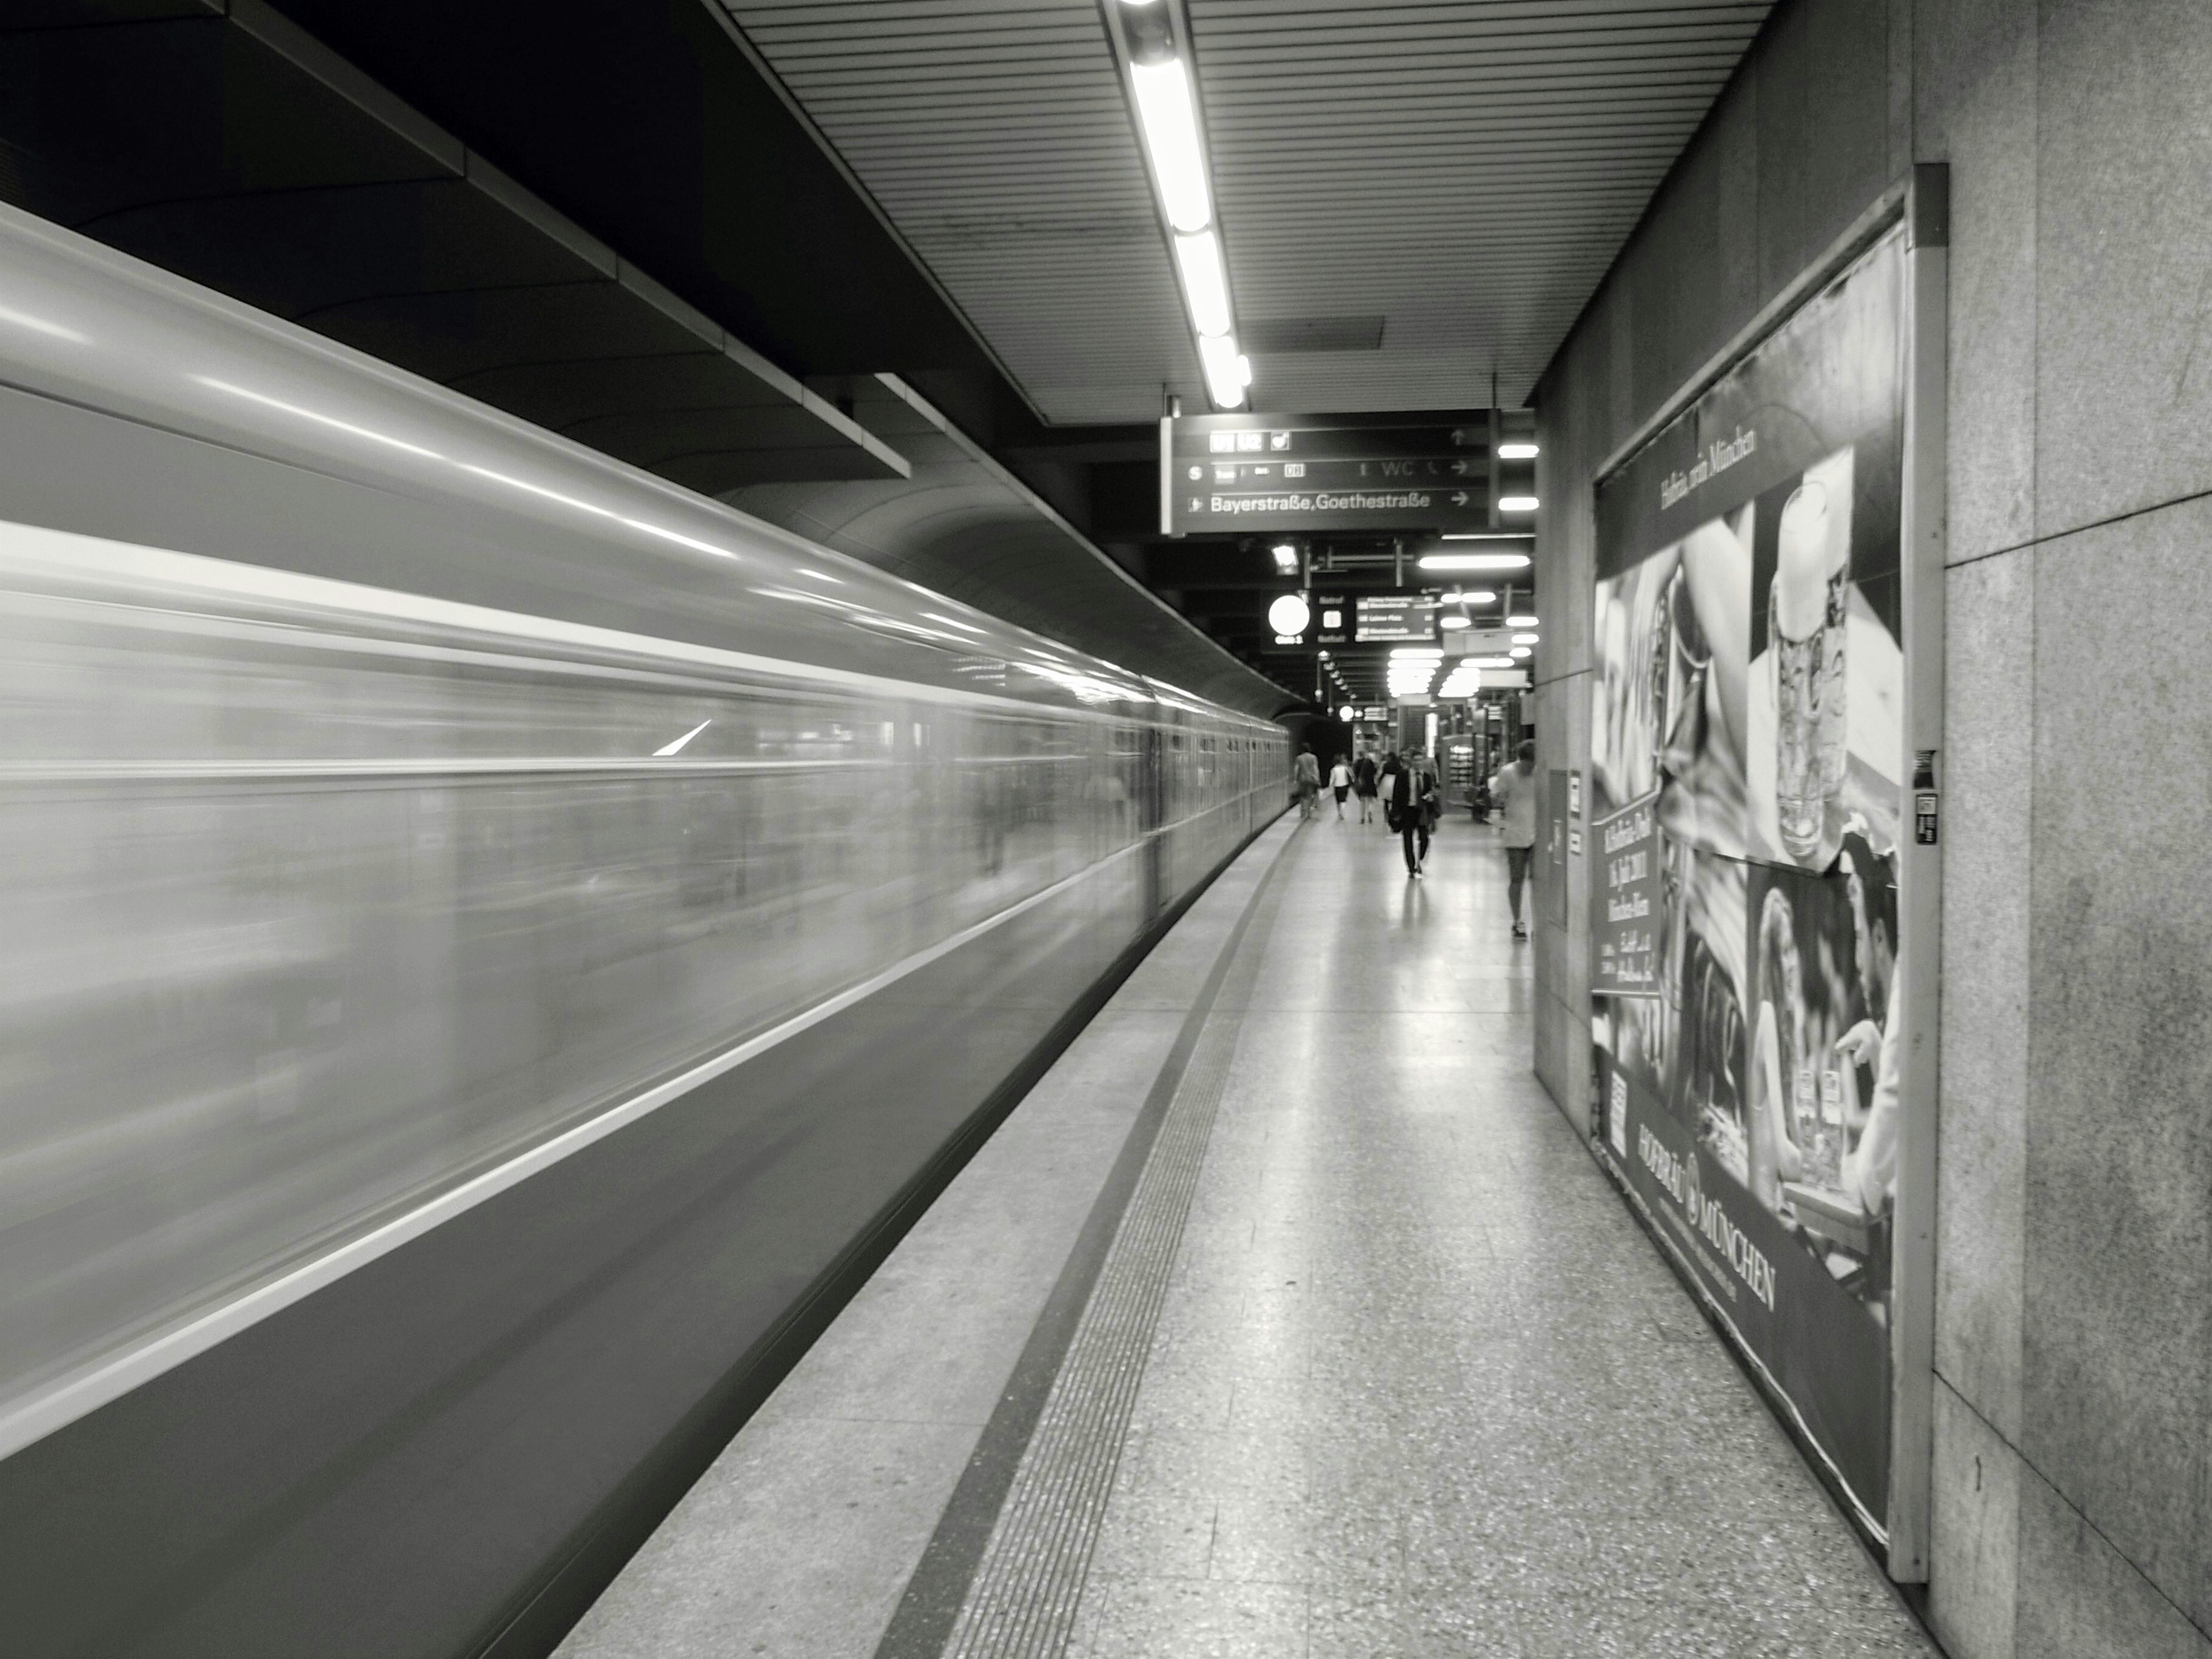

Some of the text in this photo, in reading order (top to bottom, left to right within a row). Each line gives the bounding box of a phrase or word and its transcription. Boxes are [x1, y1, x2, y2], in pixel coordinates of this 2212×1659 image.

[1238, 434, 1261, 451] U2
[1709, 424, 1756, 477] München
[1381, 461, 1413, 476] WC
[1698, 1192, 1775, 1312] MÜNCHEN
